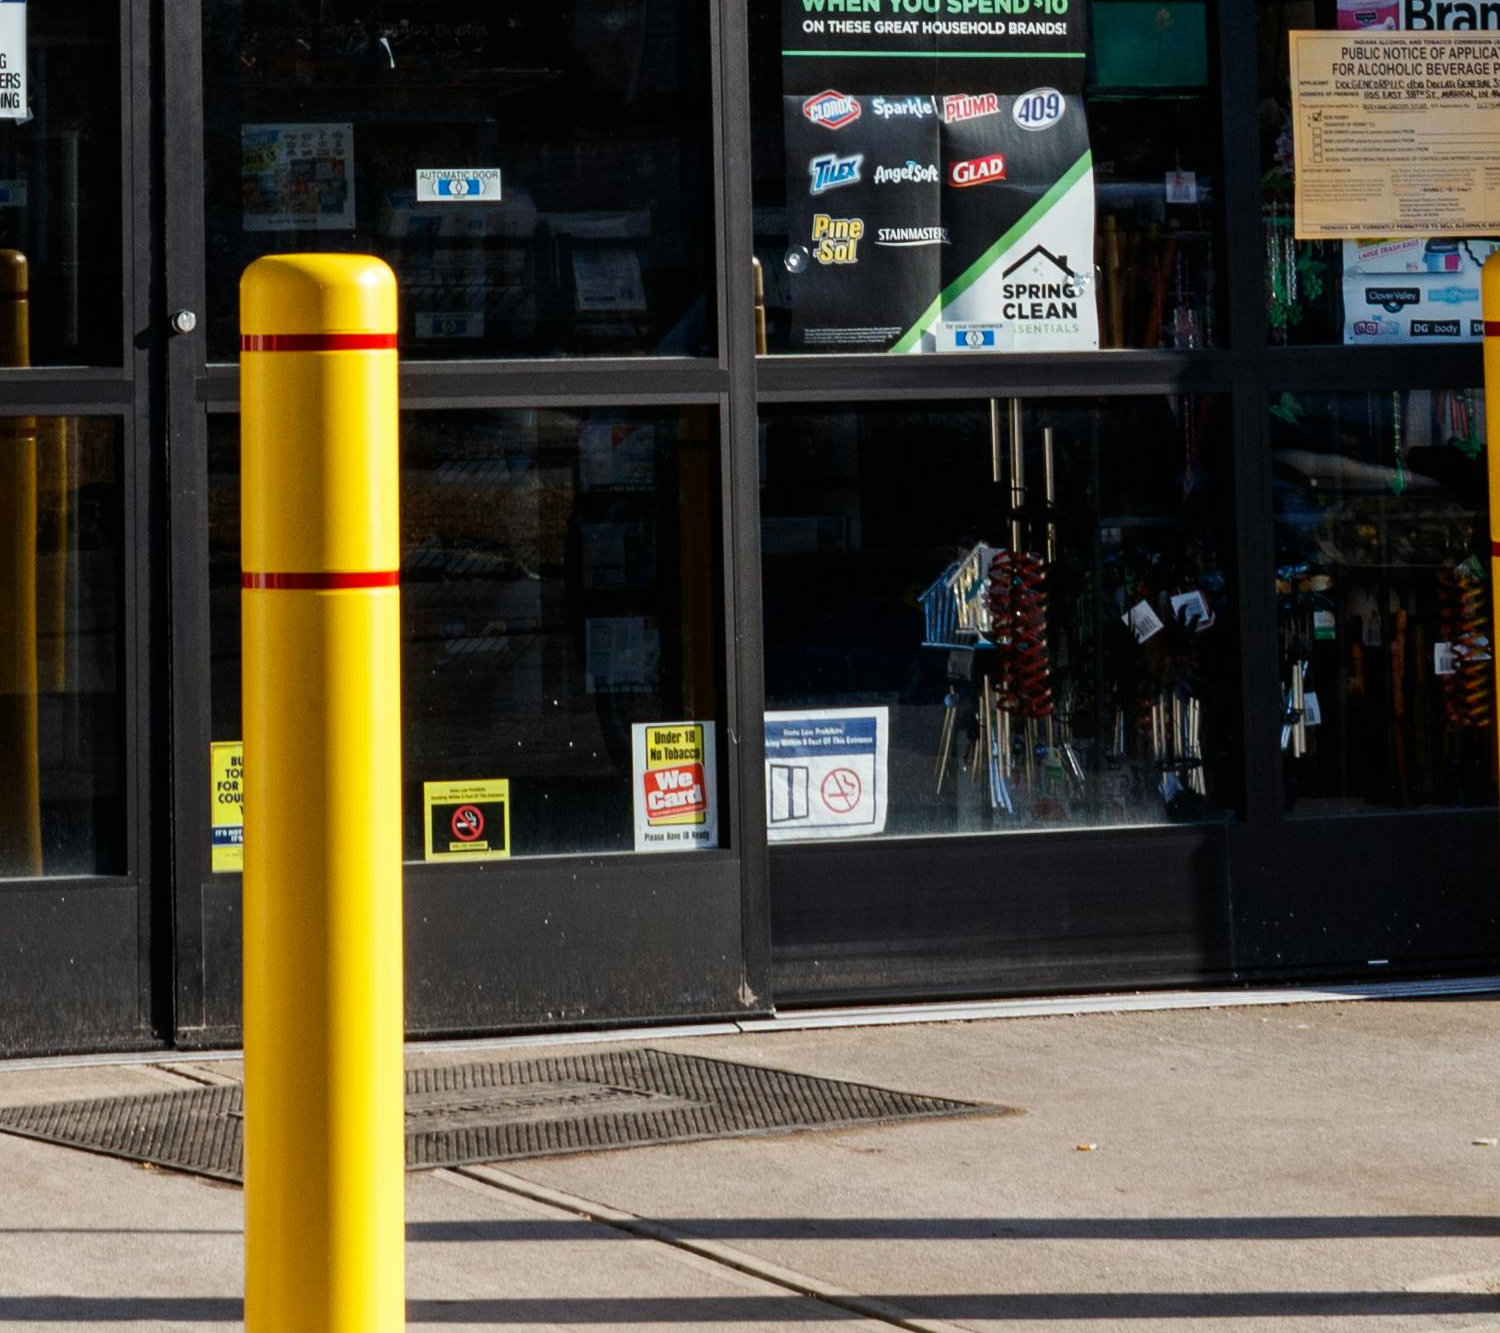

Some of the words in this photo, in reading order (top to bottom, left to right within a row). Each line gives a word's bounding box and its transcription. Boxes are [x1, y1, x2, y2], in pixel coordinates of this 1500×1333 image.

[802, 20, 825, 34] ON
[827, 21, 872, 34] THESE
[874, 21, 919, 34] GREAT
[922, 21, 1006, 35] HOUSEHOLD
[1008, 22, 1067, 35] BRANDS!
[1341, 47, 1381, 60] PUBLIC
[1383, 47, 1427, 60] NOTICE
[1430, 47, 1446, 60] OF
[1332, 63, 1356, 76] FOR
[1358, 63, 1423, 76] ALCOHOLIC
[1426, 62, 1490, 75] BEVERAGE
[810, 96, 854, 122] CLOROX
[873, 97, 933, 119] Sparkle
[945, 94, 999, 120] PLUMR
[1017, 93, 1061, 123] 409
[419, 170, 471, 180] AUTOMATIC
[473, 170, 499, 180] DOOR
[952, 159, 1004, 184] GLAD
[1002, 284, 1076, 300] SPRING
[1002, 302, 1078, 320] CLEAN
[1014, 323, 1080, 334] SENTIALS
[1413, 324, 1429, 333] DG
[1434, 323, 1458, 334] body
[654, 731, 682, 745] Under
[685, 730, 697, 743] 18
[650, 748, 663, 761] No
[664, 746, 702, 761] Tobacco
[217, 780, 239, 792] FOR
[654, 769, 694, 790] We
[647, 784, 703, 811] Card
